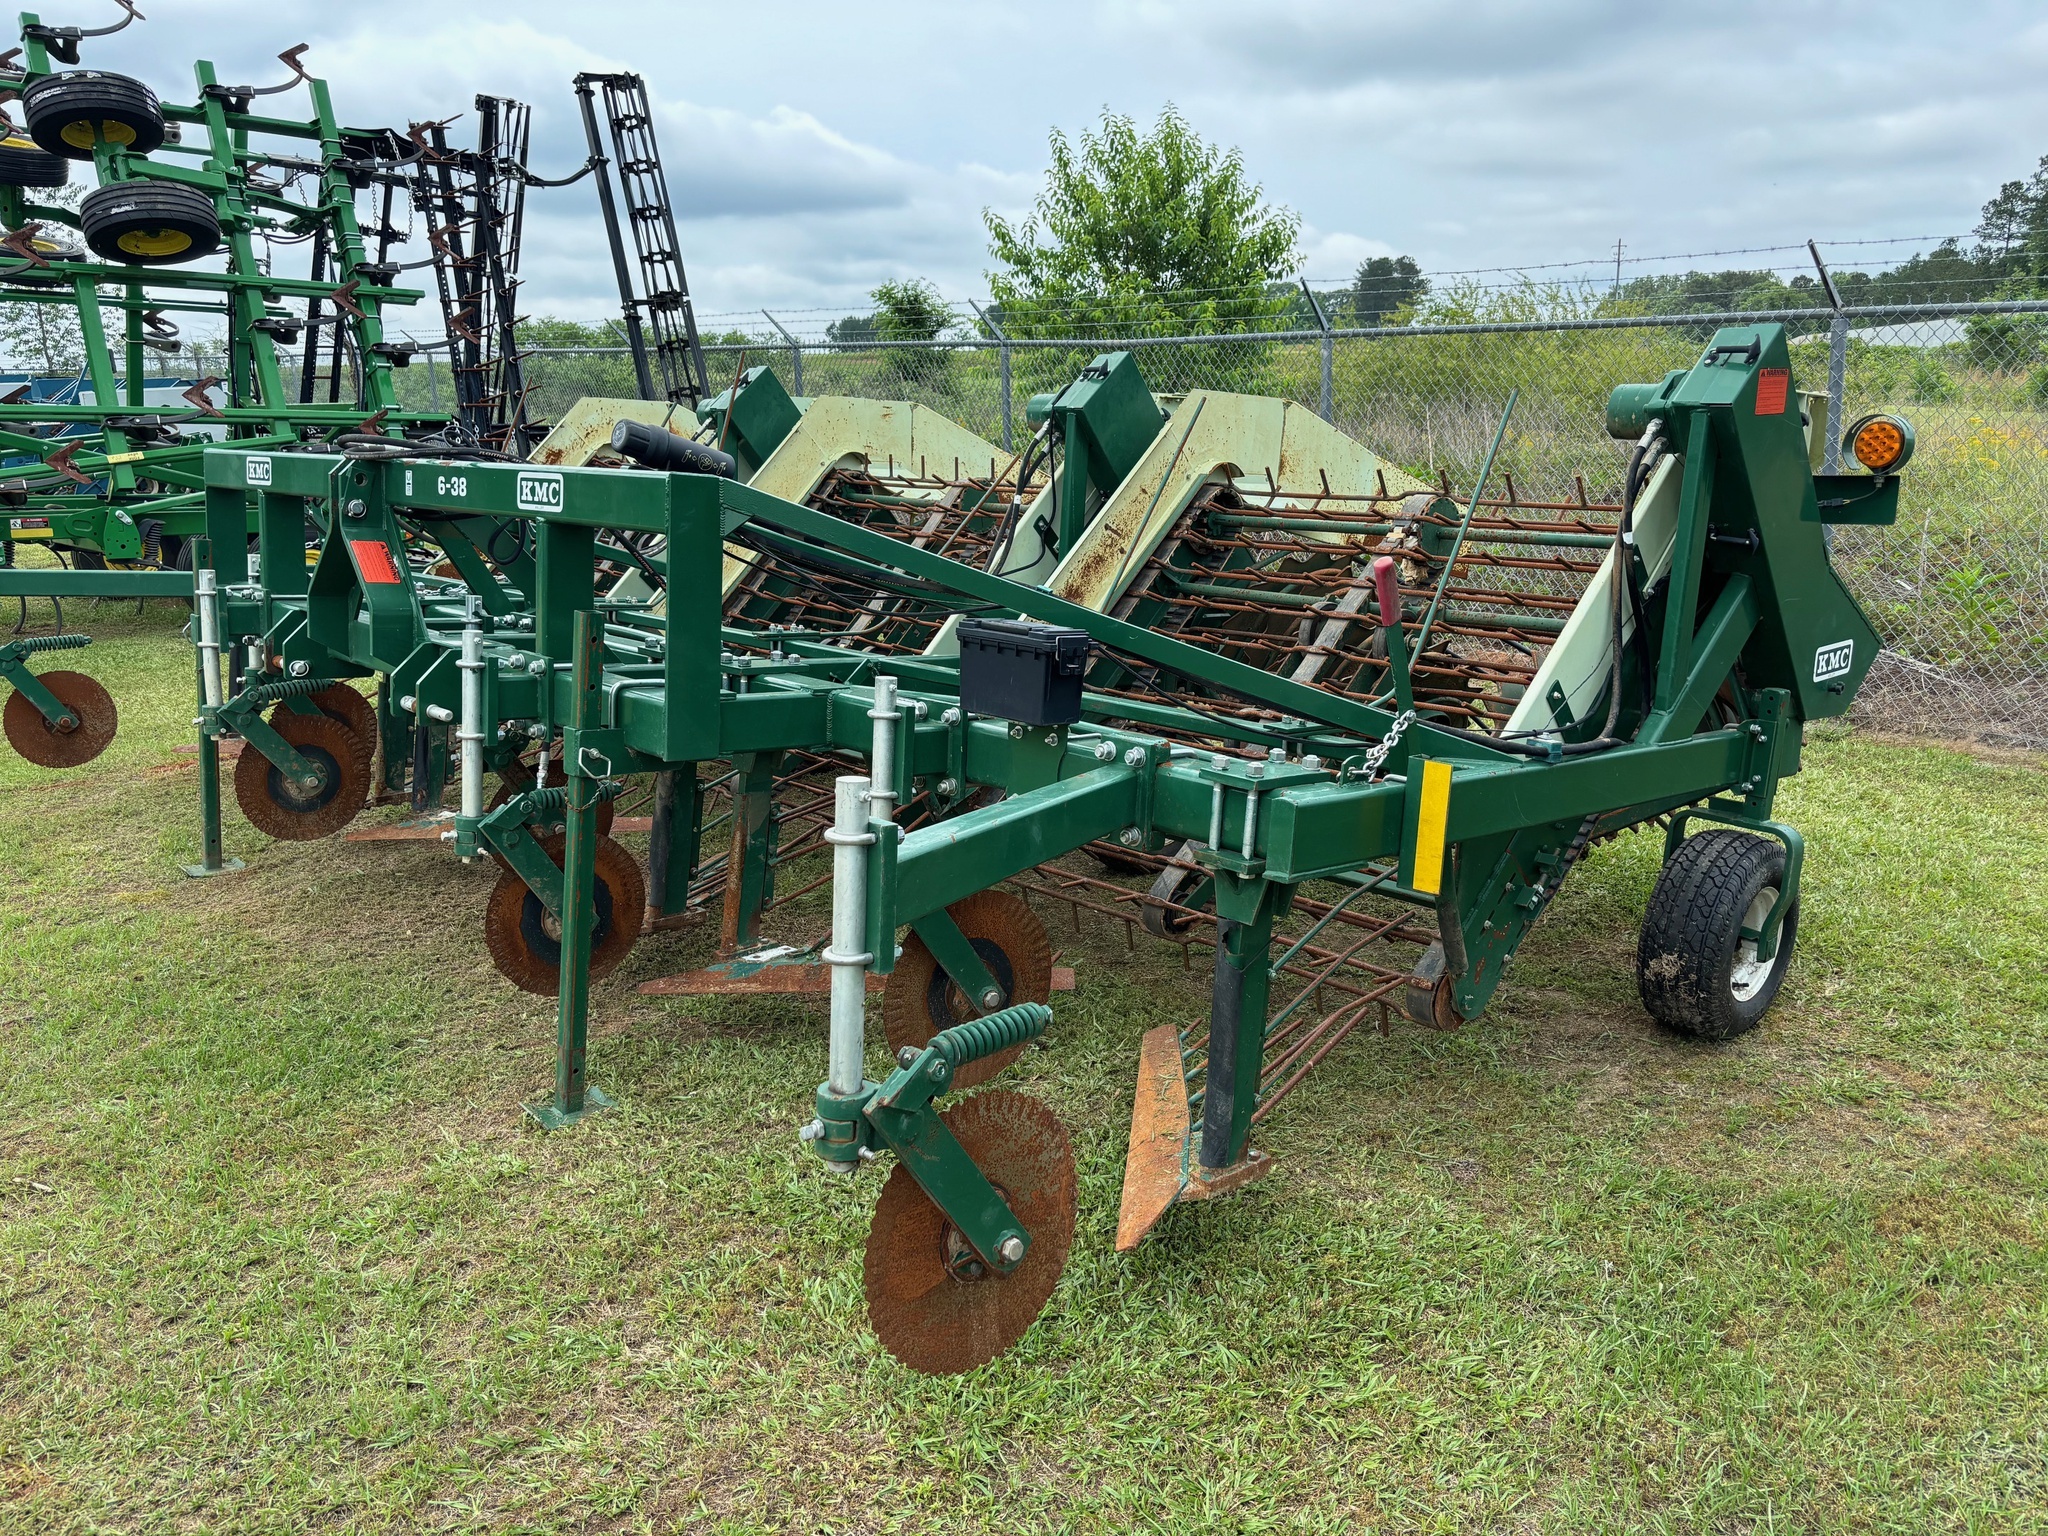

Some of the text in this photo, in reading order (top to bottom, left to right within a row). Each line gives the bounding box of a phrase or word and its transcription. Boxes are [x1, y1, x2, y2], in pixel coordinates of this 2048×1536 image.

[248, 462, 270, 480] KMC
[438, 475, 467, 497] 6-38
[520, 480, 560, 504] KMC
[384, 551, 401, 581] WARNING
[1816, 647, 1850, 674] KMC
